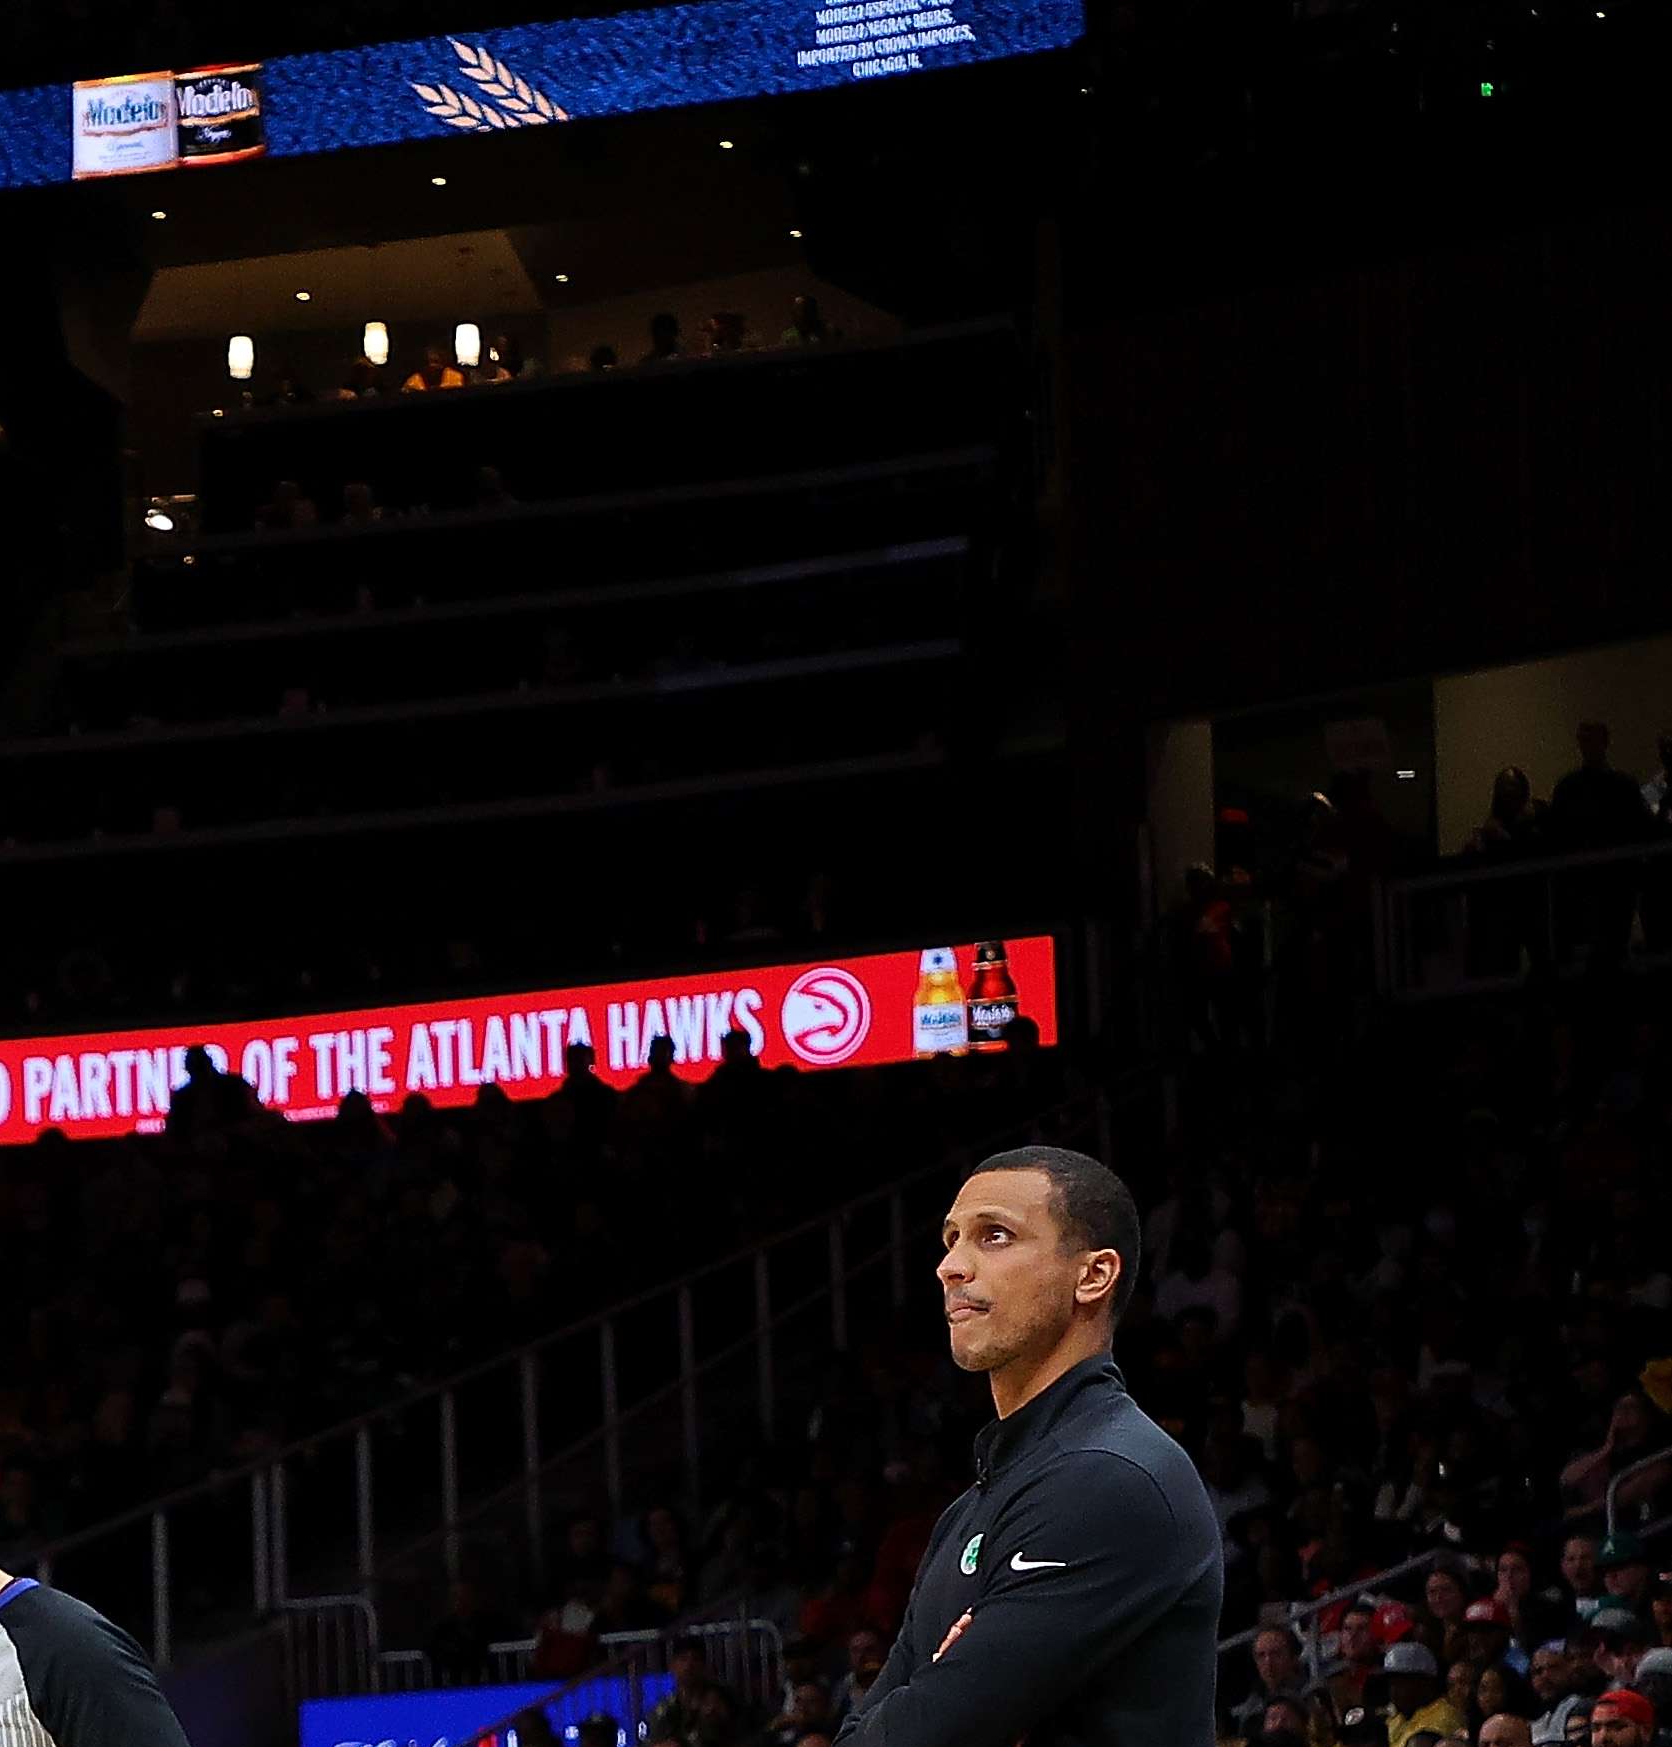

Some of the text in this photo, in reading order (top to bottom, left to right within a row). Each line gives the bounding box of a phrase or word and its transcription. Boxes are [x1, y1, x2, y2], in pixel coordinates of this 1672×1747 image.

[23, 1043, 229, 1125] PARTN
[241, 1037, 300, 1106] OF
[313, 1024, 395, 1100] THE
[406, 1006, 592, 1092] ATLANTA
[607, 988, 765, 1071] HAWKS
